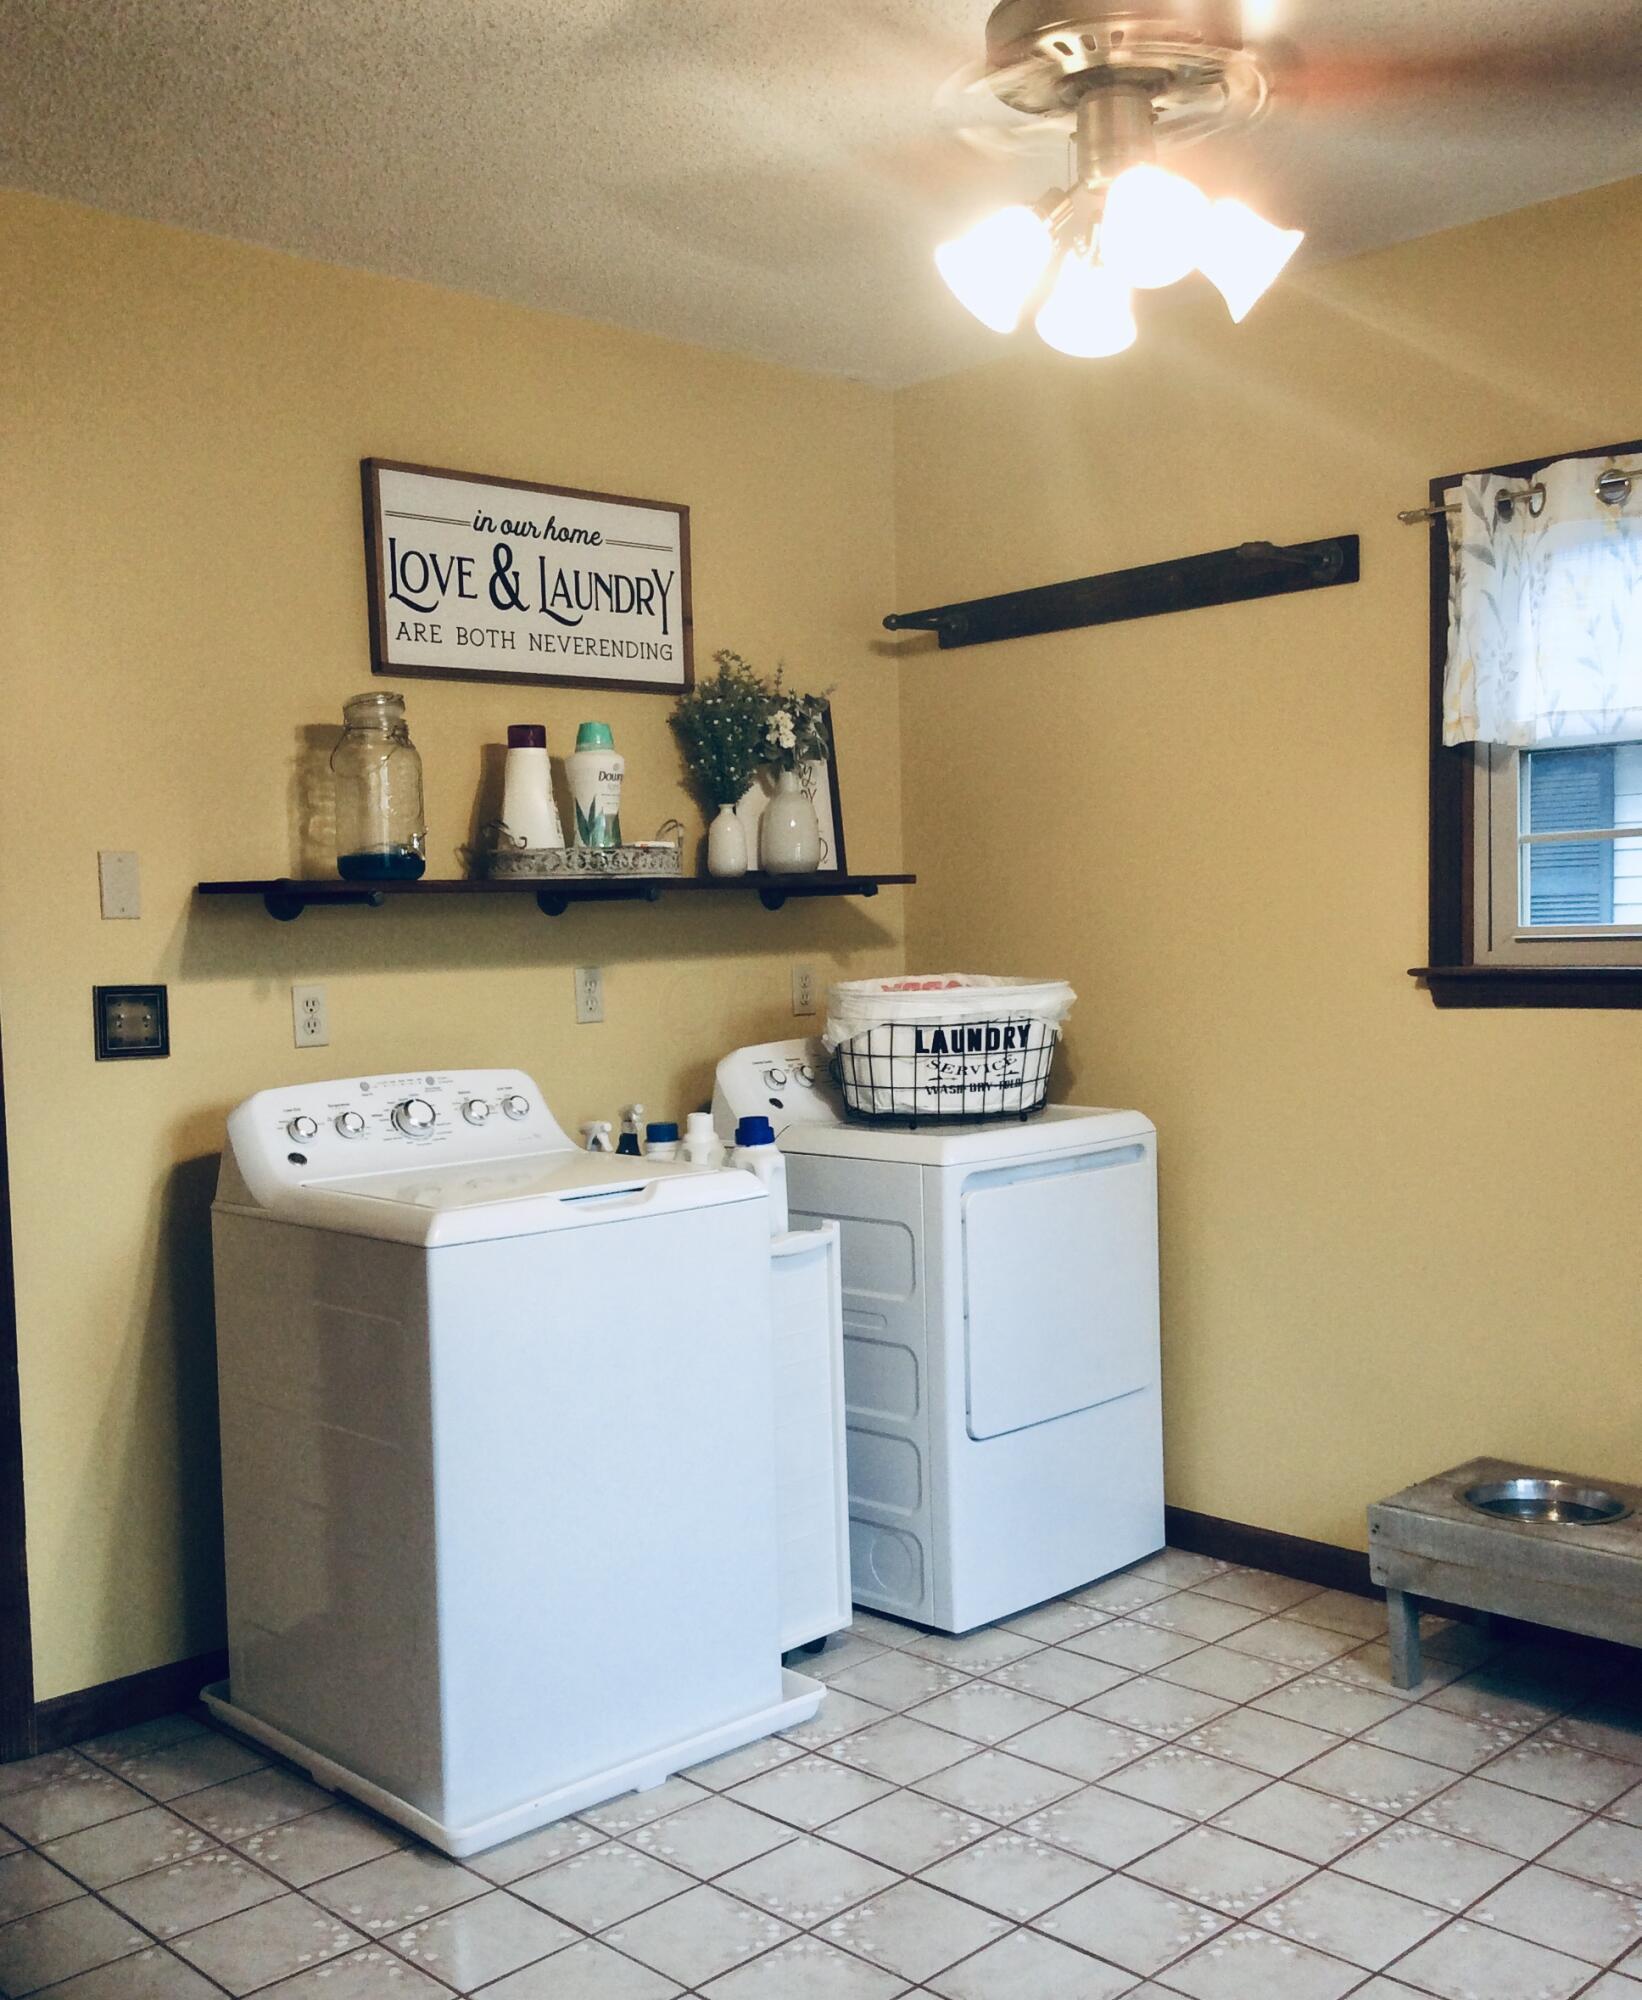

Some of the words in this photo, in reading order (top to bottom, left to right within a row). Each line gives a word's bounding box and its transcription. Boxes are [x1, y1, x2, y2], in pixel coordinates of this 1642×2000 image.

[473, 510, 498, 534] in
[500, 517, 541, 541] our
[544, 516, 603, 546] home
[388, 537, 478, 613] LOVE
[488, 542, 530, 612] &
[538, 555, 675, 635] LAUNDRY
[395, 621, 443, 644] ARE
[456, 628, 516, 650] BOTH
[529, 632, 673, 662] NEVERENDING
[598, 770, 624, 784] Down
[915, 1024, 1031, 1054] LAUNDRY
[926, 1054, 1018, 1076] SERVICE
